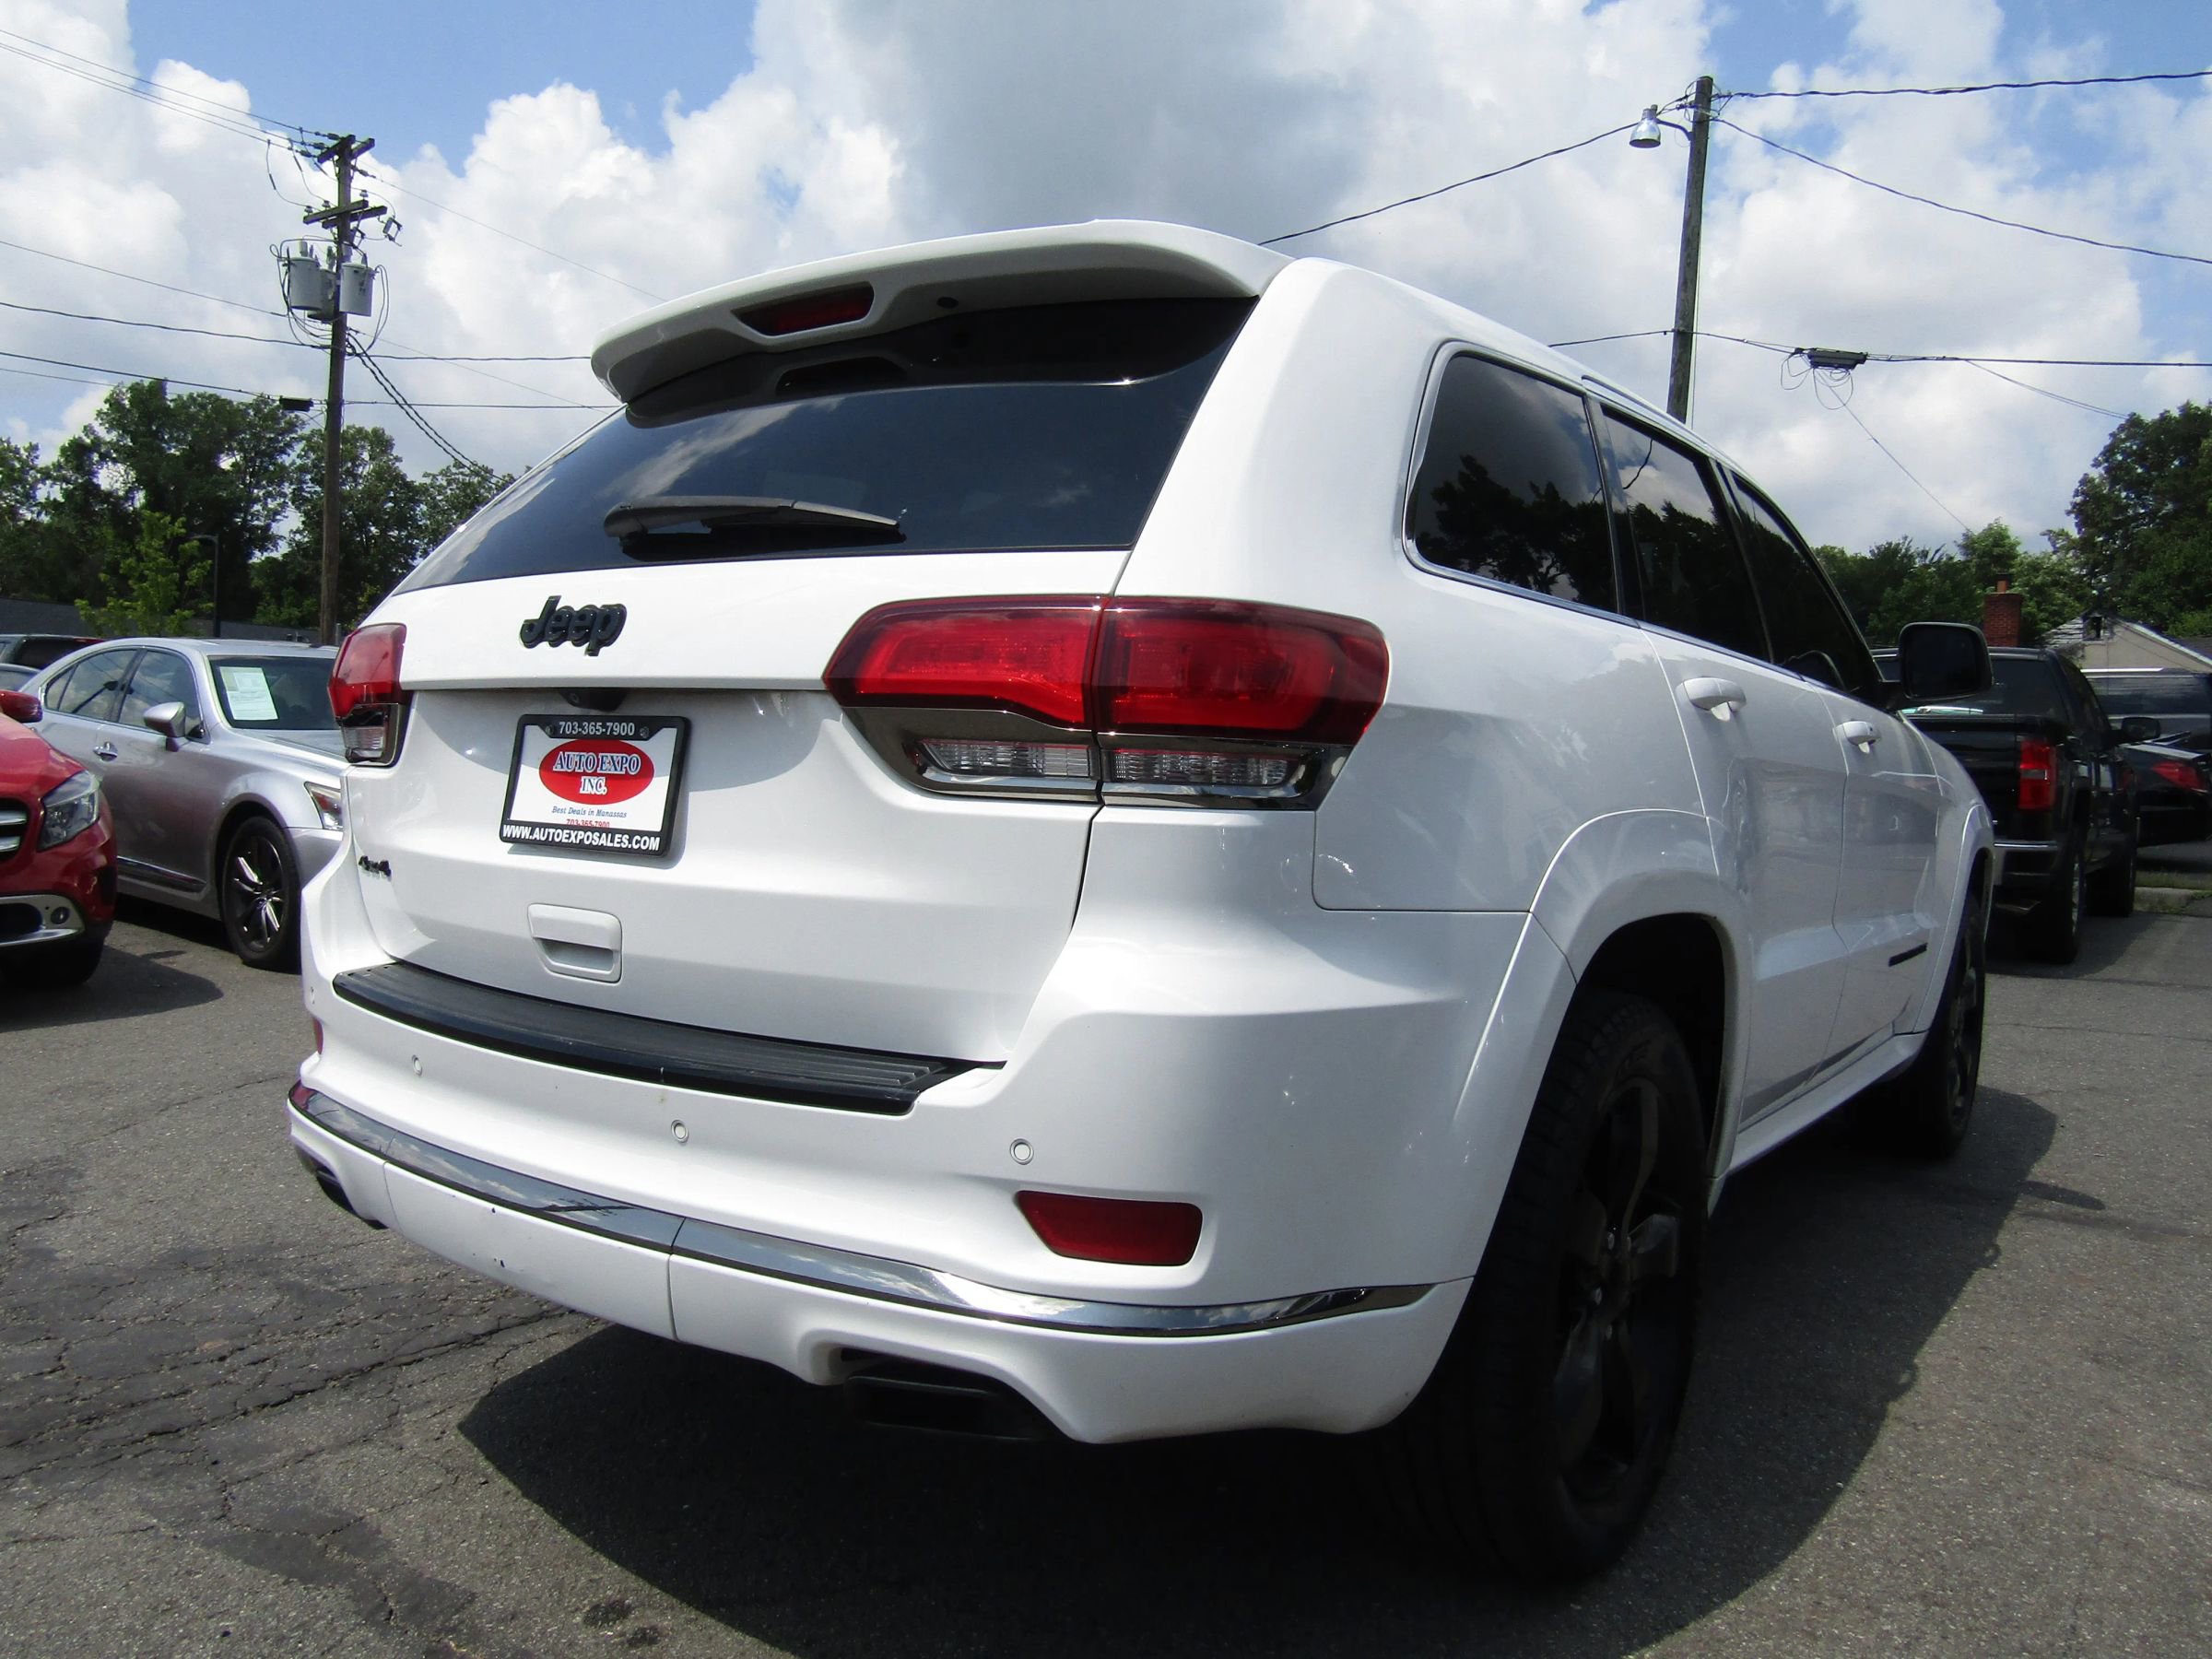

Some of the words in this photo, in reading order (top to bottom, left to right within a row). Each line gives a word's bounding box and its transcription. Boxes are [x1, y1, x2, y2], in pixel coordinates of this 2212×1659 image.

[520, 595, 628, 656] Jeep
[559, 721, 635, 735] 703-365-7900
[553, 751, 597, 771] AUTO
[598, 753, 641, 774] EXPO
[580, 776, 607, 795] INC.
[552, 806, 567, 814] Best
[569, 807, 587, 817] Deals
[588, 809, 594, 818] in
[595, 810, 627, 818] Manassas
[502, 824, 660, 851] WWW.AUTOEXPOSALES.COM
